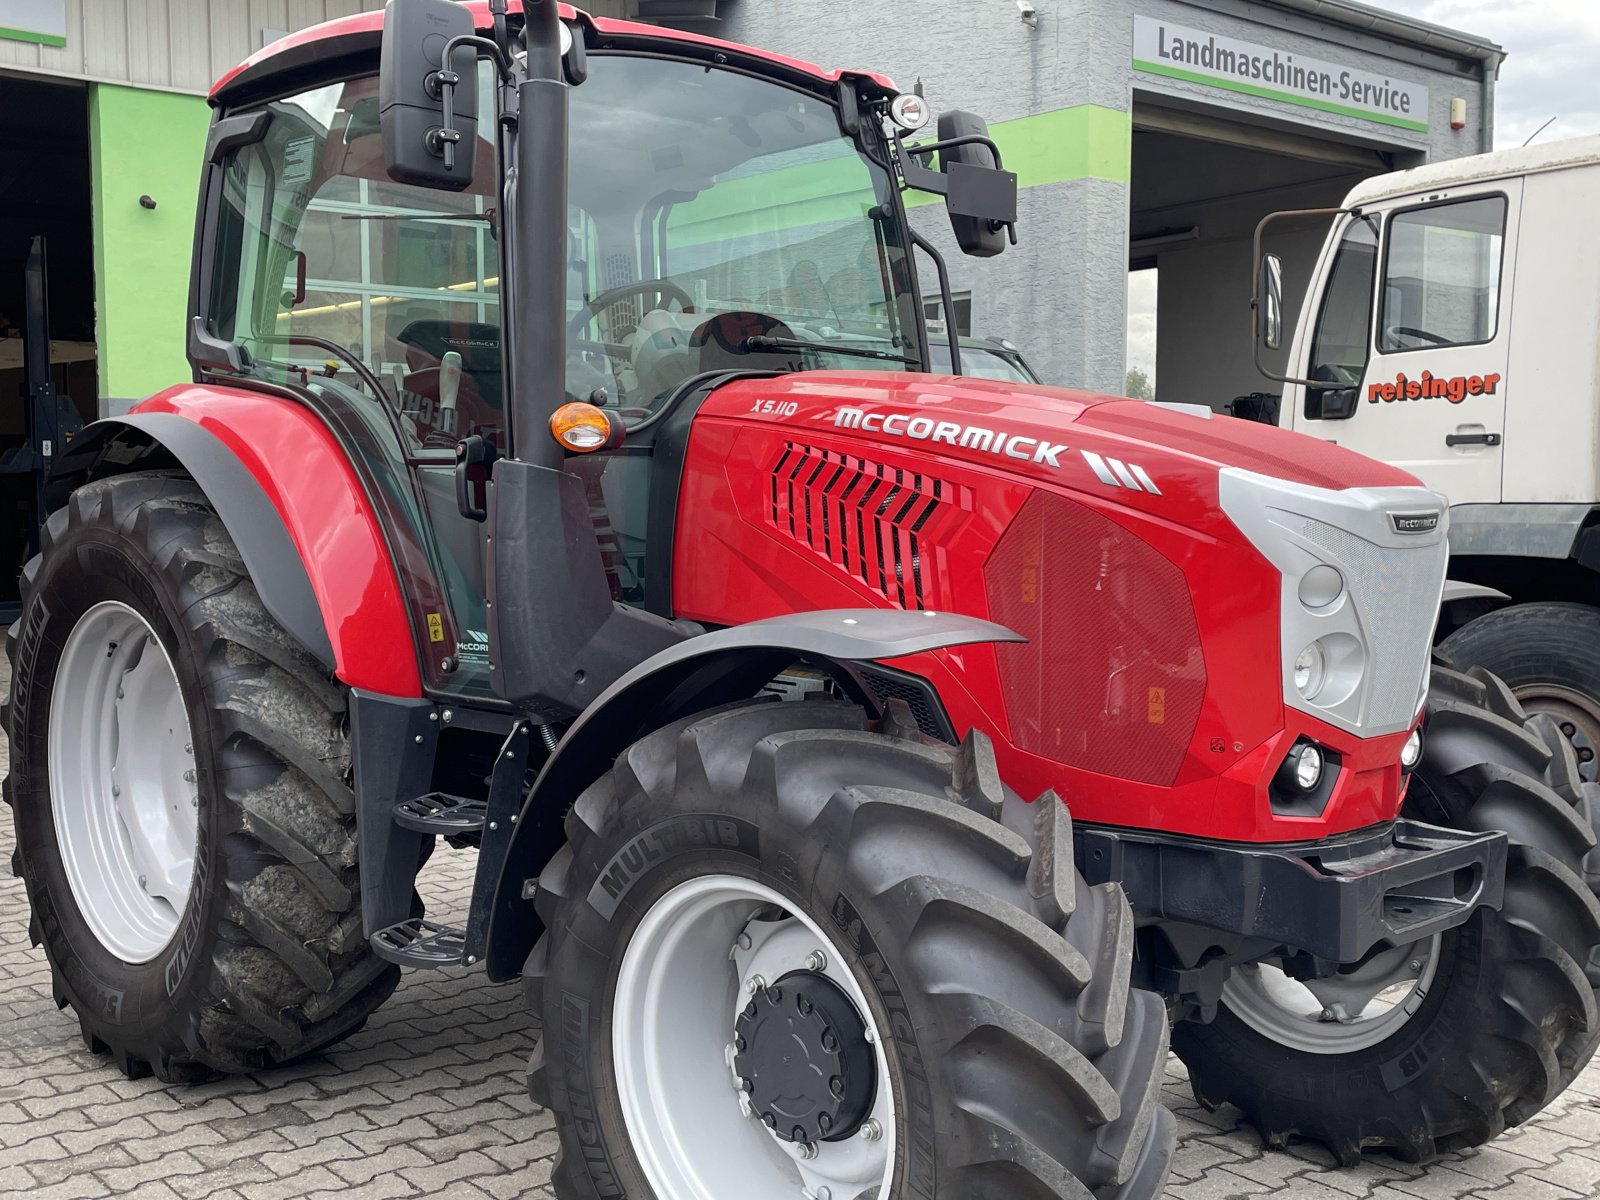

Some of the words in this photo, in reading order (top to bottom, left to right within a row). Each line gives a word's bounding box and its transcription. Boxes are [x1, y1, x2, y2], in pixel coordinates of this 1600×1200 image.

[1158, 26, 1411, 113] Landmaschinen-Service
[1368, 370, 1501, 404] reisinger
[750, 399, 798, 417] X5.110
[456, 642, 489, 652] McCOR
[600, 819, 740, 900] MULTIBIB
